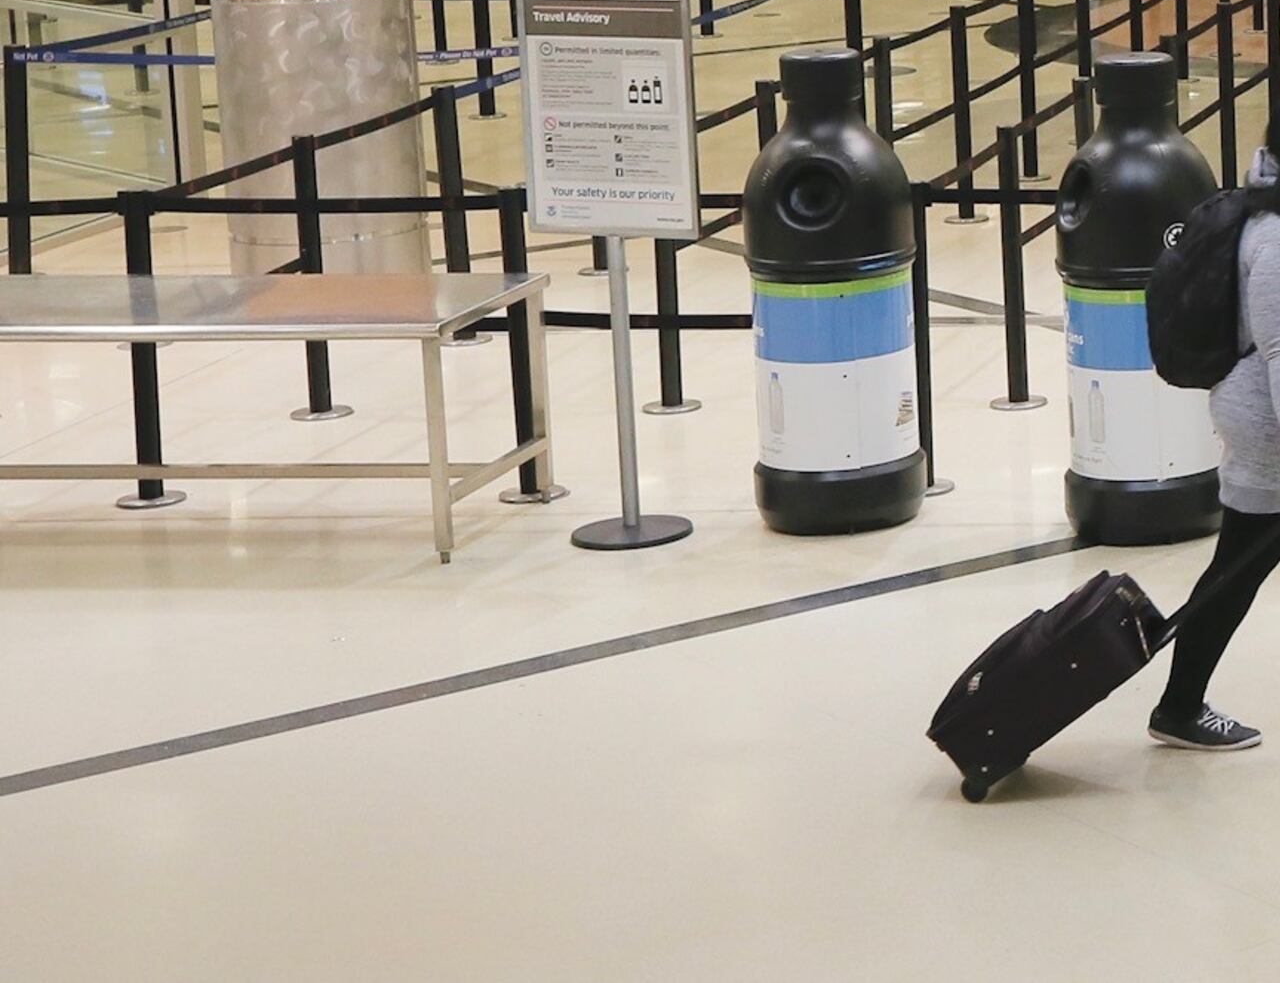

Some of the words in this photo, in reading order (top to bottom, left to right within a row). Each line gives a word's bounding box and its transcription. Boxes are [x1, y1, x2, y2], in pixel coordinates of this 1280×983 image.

[533, 12, 565, 22] Travel
[566, 12, 610, 25] Advisory
[552, 186, 574, 197] Your
[576, 187, 607, 198] safety
[609, 189, 617, 198] is
[619, 191, 636, 199] our
[638, 189, 676, 202] priority
